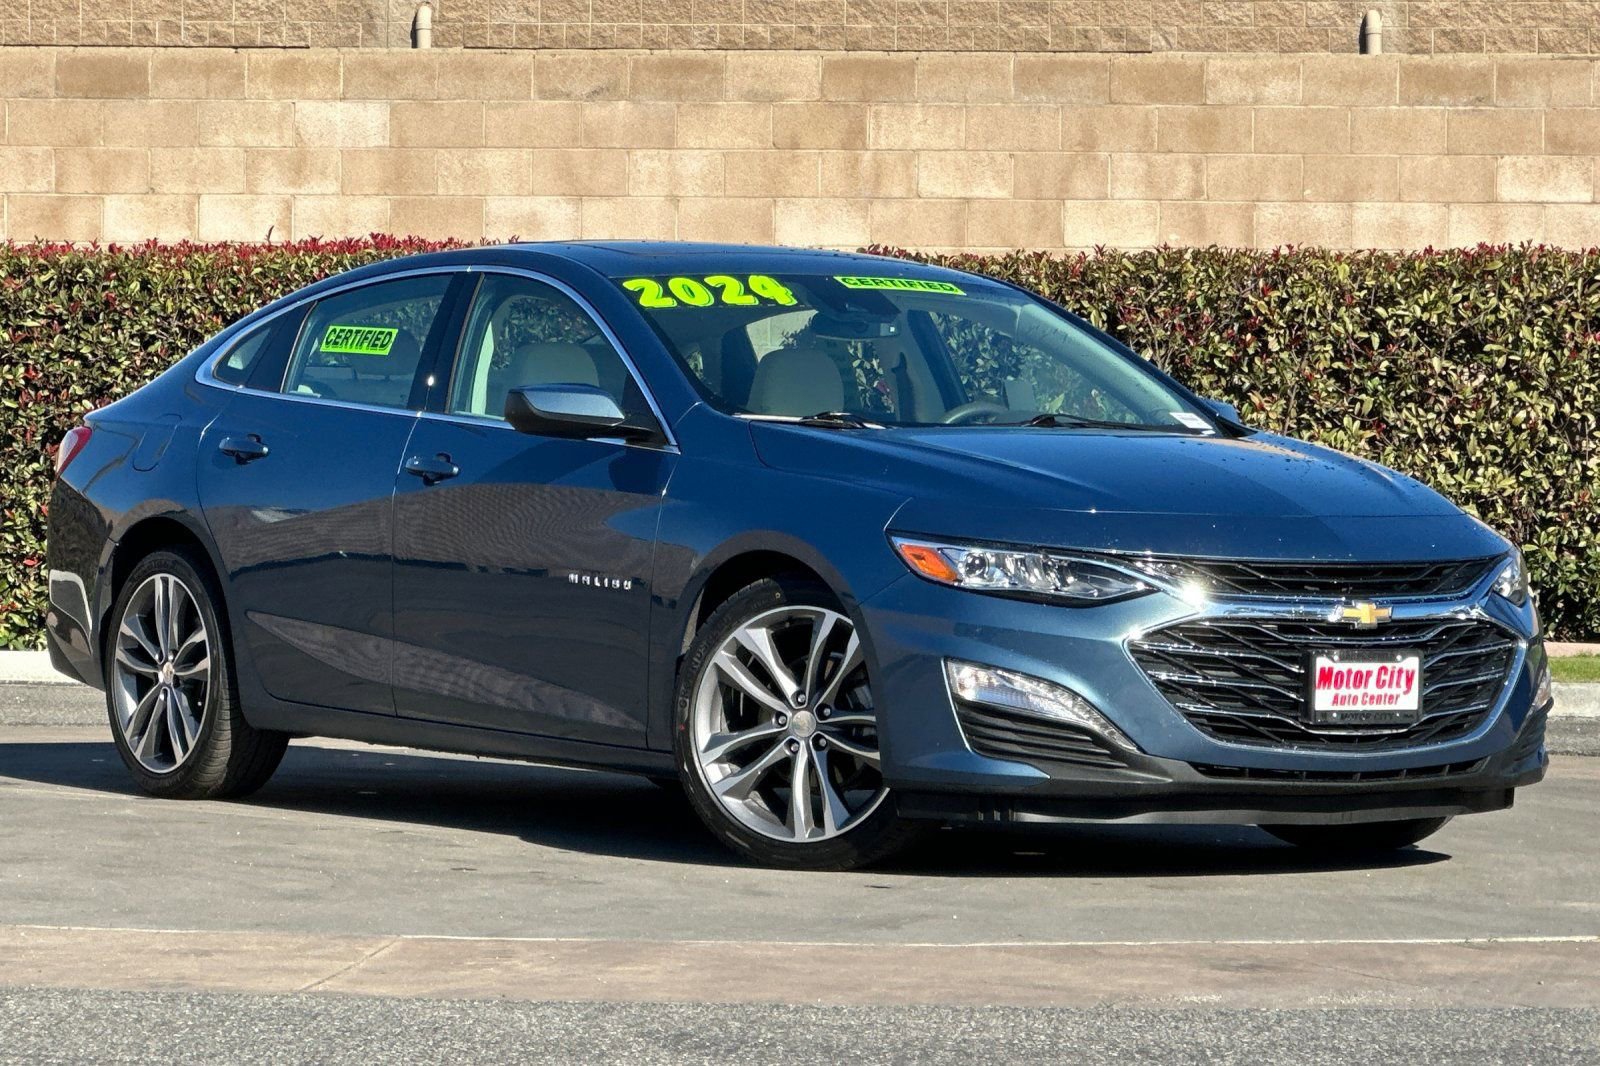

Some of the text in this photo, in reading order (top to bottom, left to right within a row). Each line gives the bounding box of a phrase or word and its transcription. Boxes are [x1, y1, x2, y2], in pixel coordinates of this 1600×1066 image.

[622, 275, 798, 307] 2024
[841, 277, 958, 292] CERTIFIED
[325, 327, 393, 350] CERTIFIED
[568, 573, 632, 590] MALIBU
[1316, 665, 1415, 695] Motor City
[1332, 692, 1400, 706] Auto Center
